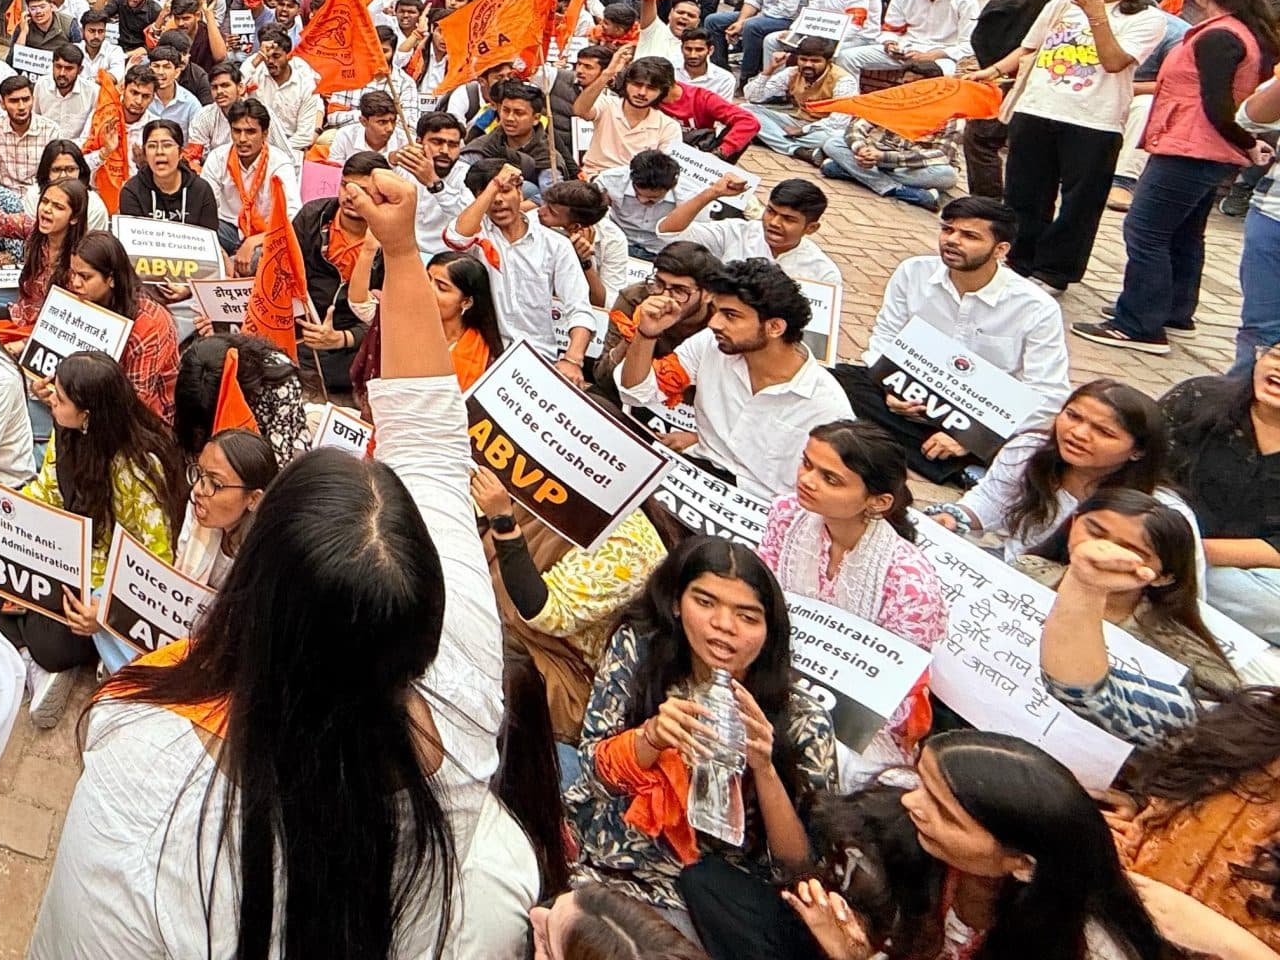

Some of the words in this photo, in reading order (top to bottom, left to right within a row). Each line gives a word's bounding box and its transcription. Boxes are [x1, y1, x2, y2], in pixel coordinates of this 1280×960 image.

[672, 150, 703, 170] Student
[704, 166, 724, 178] unio
[130, 228, 154, 237] Voice
[167, 232, 205, 243] Students
[132, 239, 154, 247] Can't
[135, 256, 199, 278] ABVP
[213, 286, 235, 300] डीयू
[221, 302, 242, 314] होश
[894, 338, 908, 350] DU
[908, 347, 944, 377] Belongs
[946, 374, 960, 386] To
[882, 370, 970, 430] ABVP
[904, 359, 920, 374] Not
[922, 372, 934, 384] To
[934, 382, 985, 418] Dictators
[333, 420, 368, 447] छात्रों
[511, 368, 538, 400] Voice
[555, 412, 627, 472] Students
[496, 386, 522, 416] Can't
[522, 412, 540, 433] Be
[540, 430, 612, 489] Crushed!
[468, 418, 568, 505] ABVP
[704, 476, 730, 496] की
[709, 500, 738, 523] बंद
[16, 526, 32, 540] The
[35, 536, 56, 550] Anti
[2, 537, 80, 576] Administration!
[126, 554, 168, 594] Voice
[129, 583, 168, 616] Can't
[172, 611, 193, 630] be
[994, 650, 1032, 676] ताज
[962, 656, 1019, 696] आवाज
[1024, 687, 1050, 718] है
